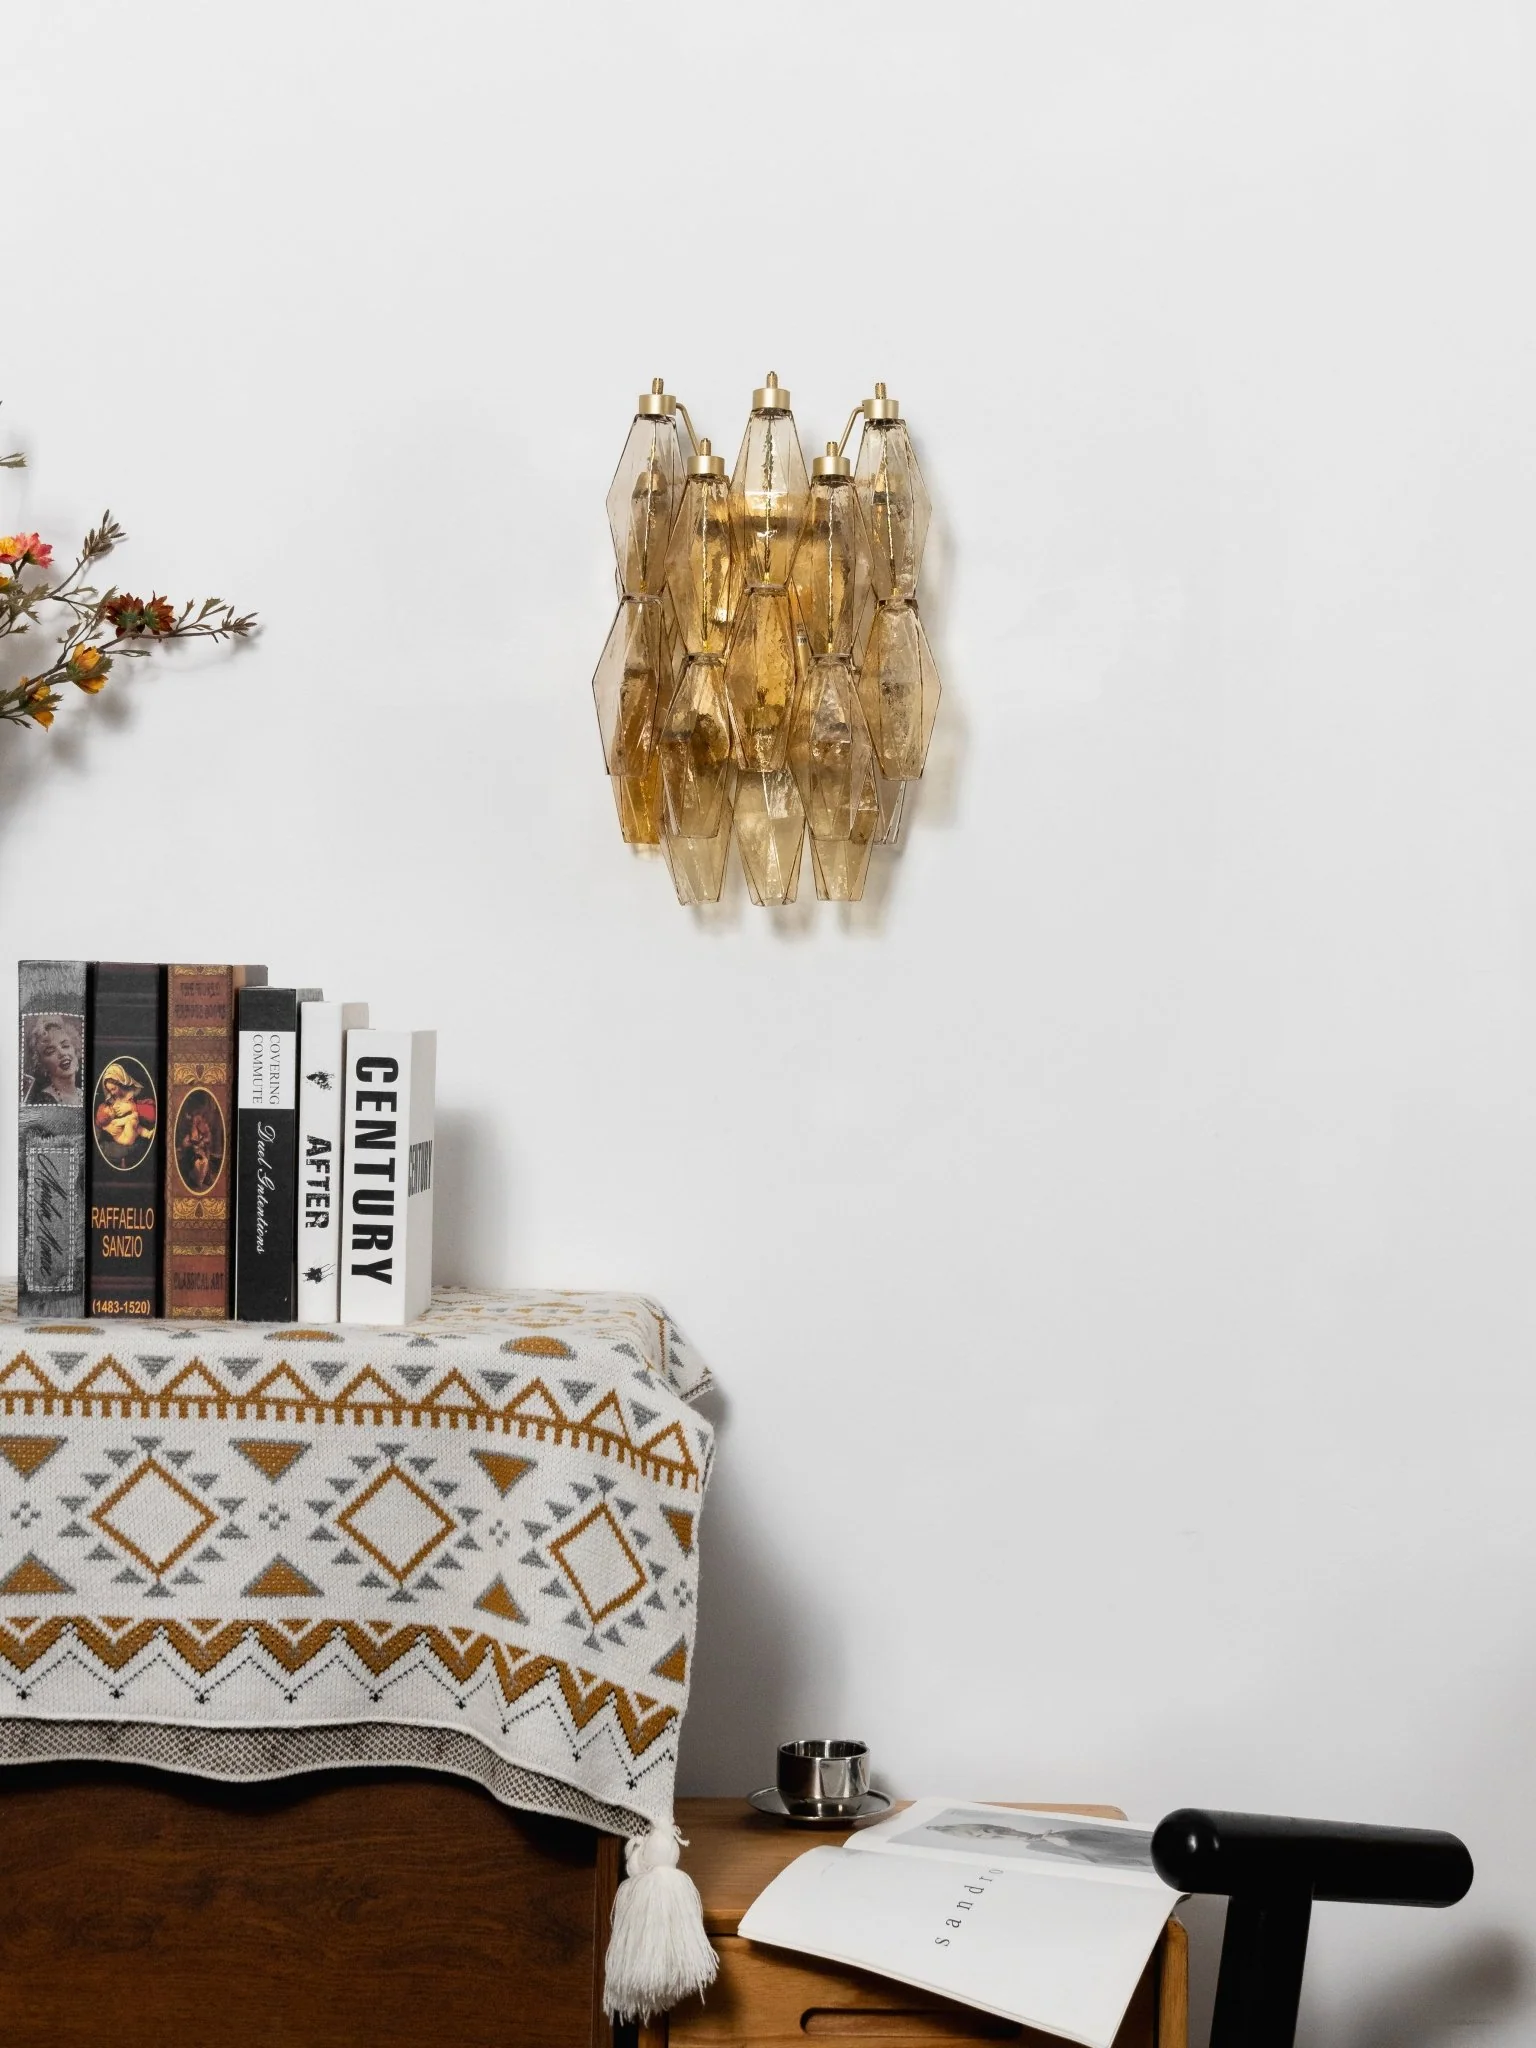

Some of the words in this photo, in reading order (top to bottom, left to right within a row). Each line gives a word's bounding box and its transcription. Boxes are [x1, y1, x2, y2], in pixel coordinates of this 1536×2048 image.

[252, 1034, 264, 1104] COMMUTE
[269, 1034, 281, 1105] COVERING
[257, 1121, 276, 1170] Duel
[351, 1056, 399, 1285] CENTURY
[408, 1140, 433, 1197] CENTURY
[256, 1168, 276, 1255] Intentions
[305, 1134, 332, 1229] AFTER
[91, 1206, 155, 1230] RAFFAELLO
[102, 1235, 143, 1258] SANZIO
[92, 1299, 151, 1315] (1483-1520)
[934, 1867, 1004, 1947] sandro
